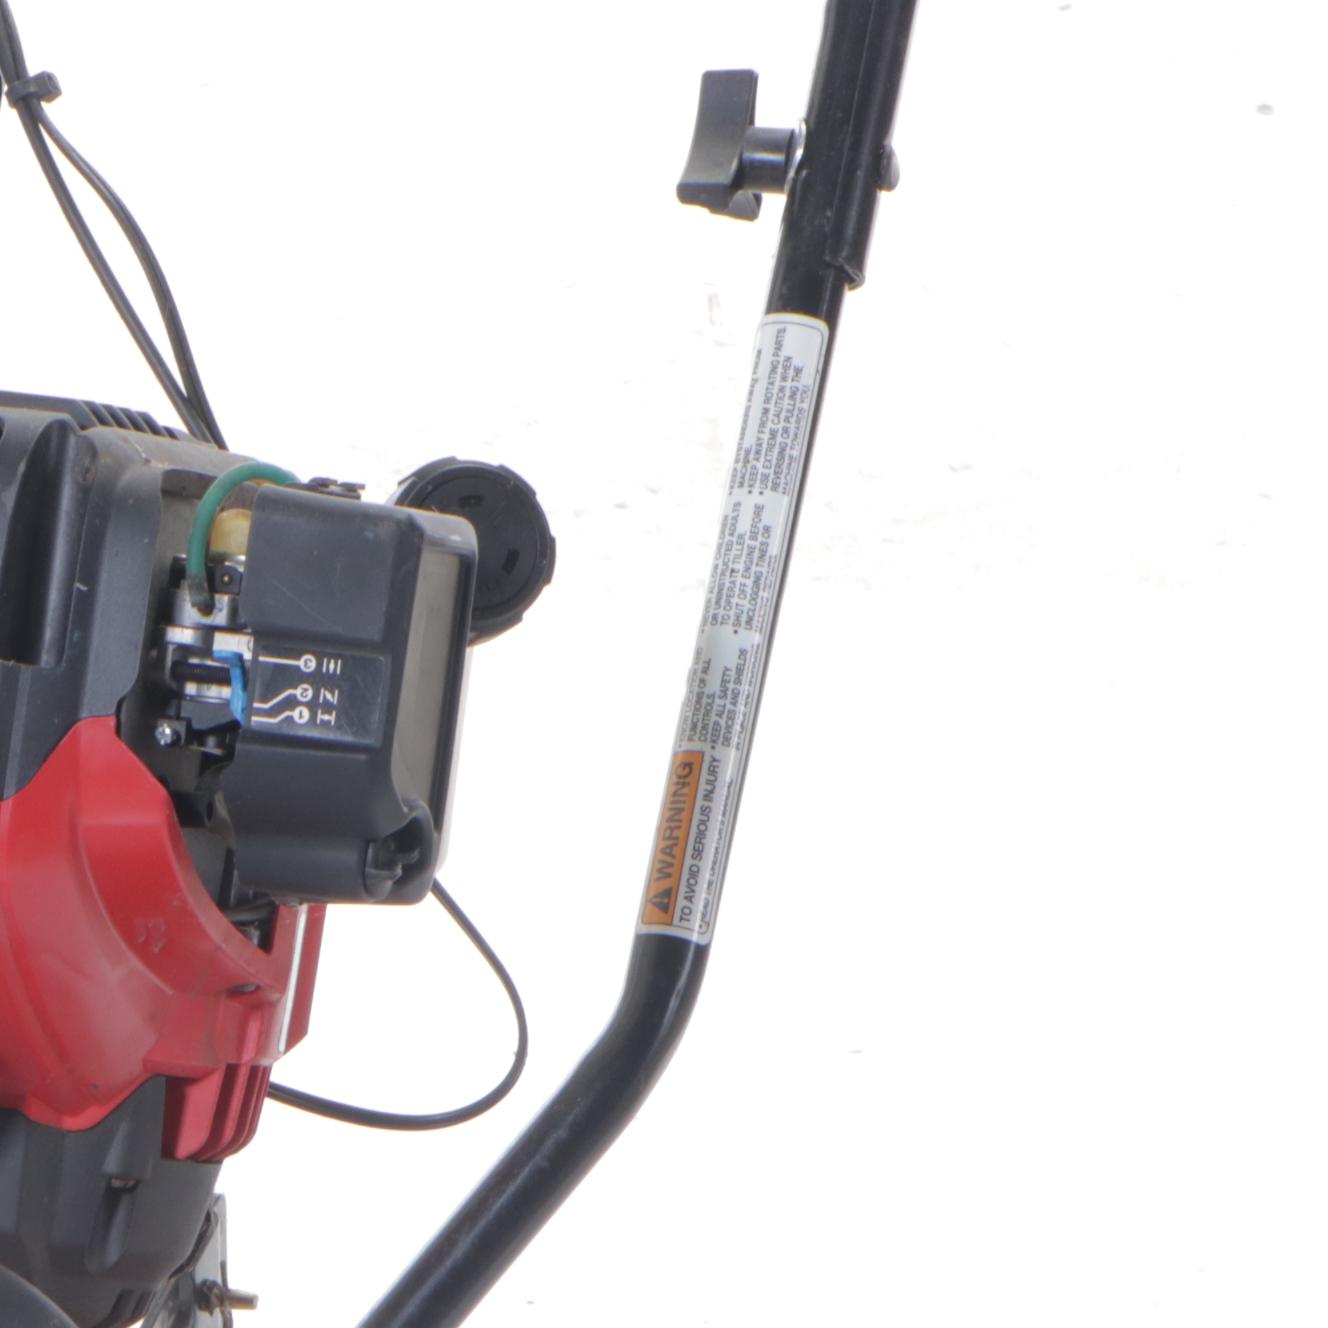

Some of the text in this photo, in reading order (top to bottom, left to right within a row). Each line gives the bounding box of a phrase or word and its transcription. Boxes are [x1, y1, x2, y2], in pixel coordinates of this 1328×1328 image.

[747, 326, 786, 488] KEEP AWAY FROM ROTATING PARTS.
[758, 355, 792, 490] USE EXTREME CAUTION WHEN
[770, 365, 803, 492] REVERSING OR PULLING THE
[709, 501, 741, 626] OR UNINSTRUCTED ADULTS
[720, 612, 730, 626] TO
[722, 567, 739, 611] OPERATE
[731, 503, 764, 627] SHUT OFF ENGINE BEFORE
[744, 524, 771, 630] UNCLOGGING TINES OR
[687, 657, 711, 742] FUNCTIONS OF ALL
[709, 665, 732, 744] KEEP ALL SAFETY
[720, 648, 748, 747] DEVICES AND SHIELDS
[655, 761, 693, 881] WARNING
[678, 754, 720, 922] TO AVOID SERIOUS INJURY
